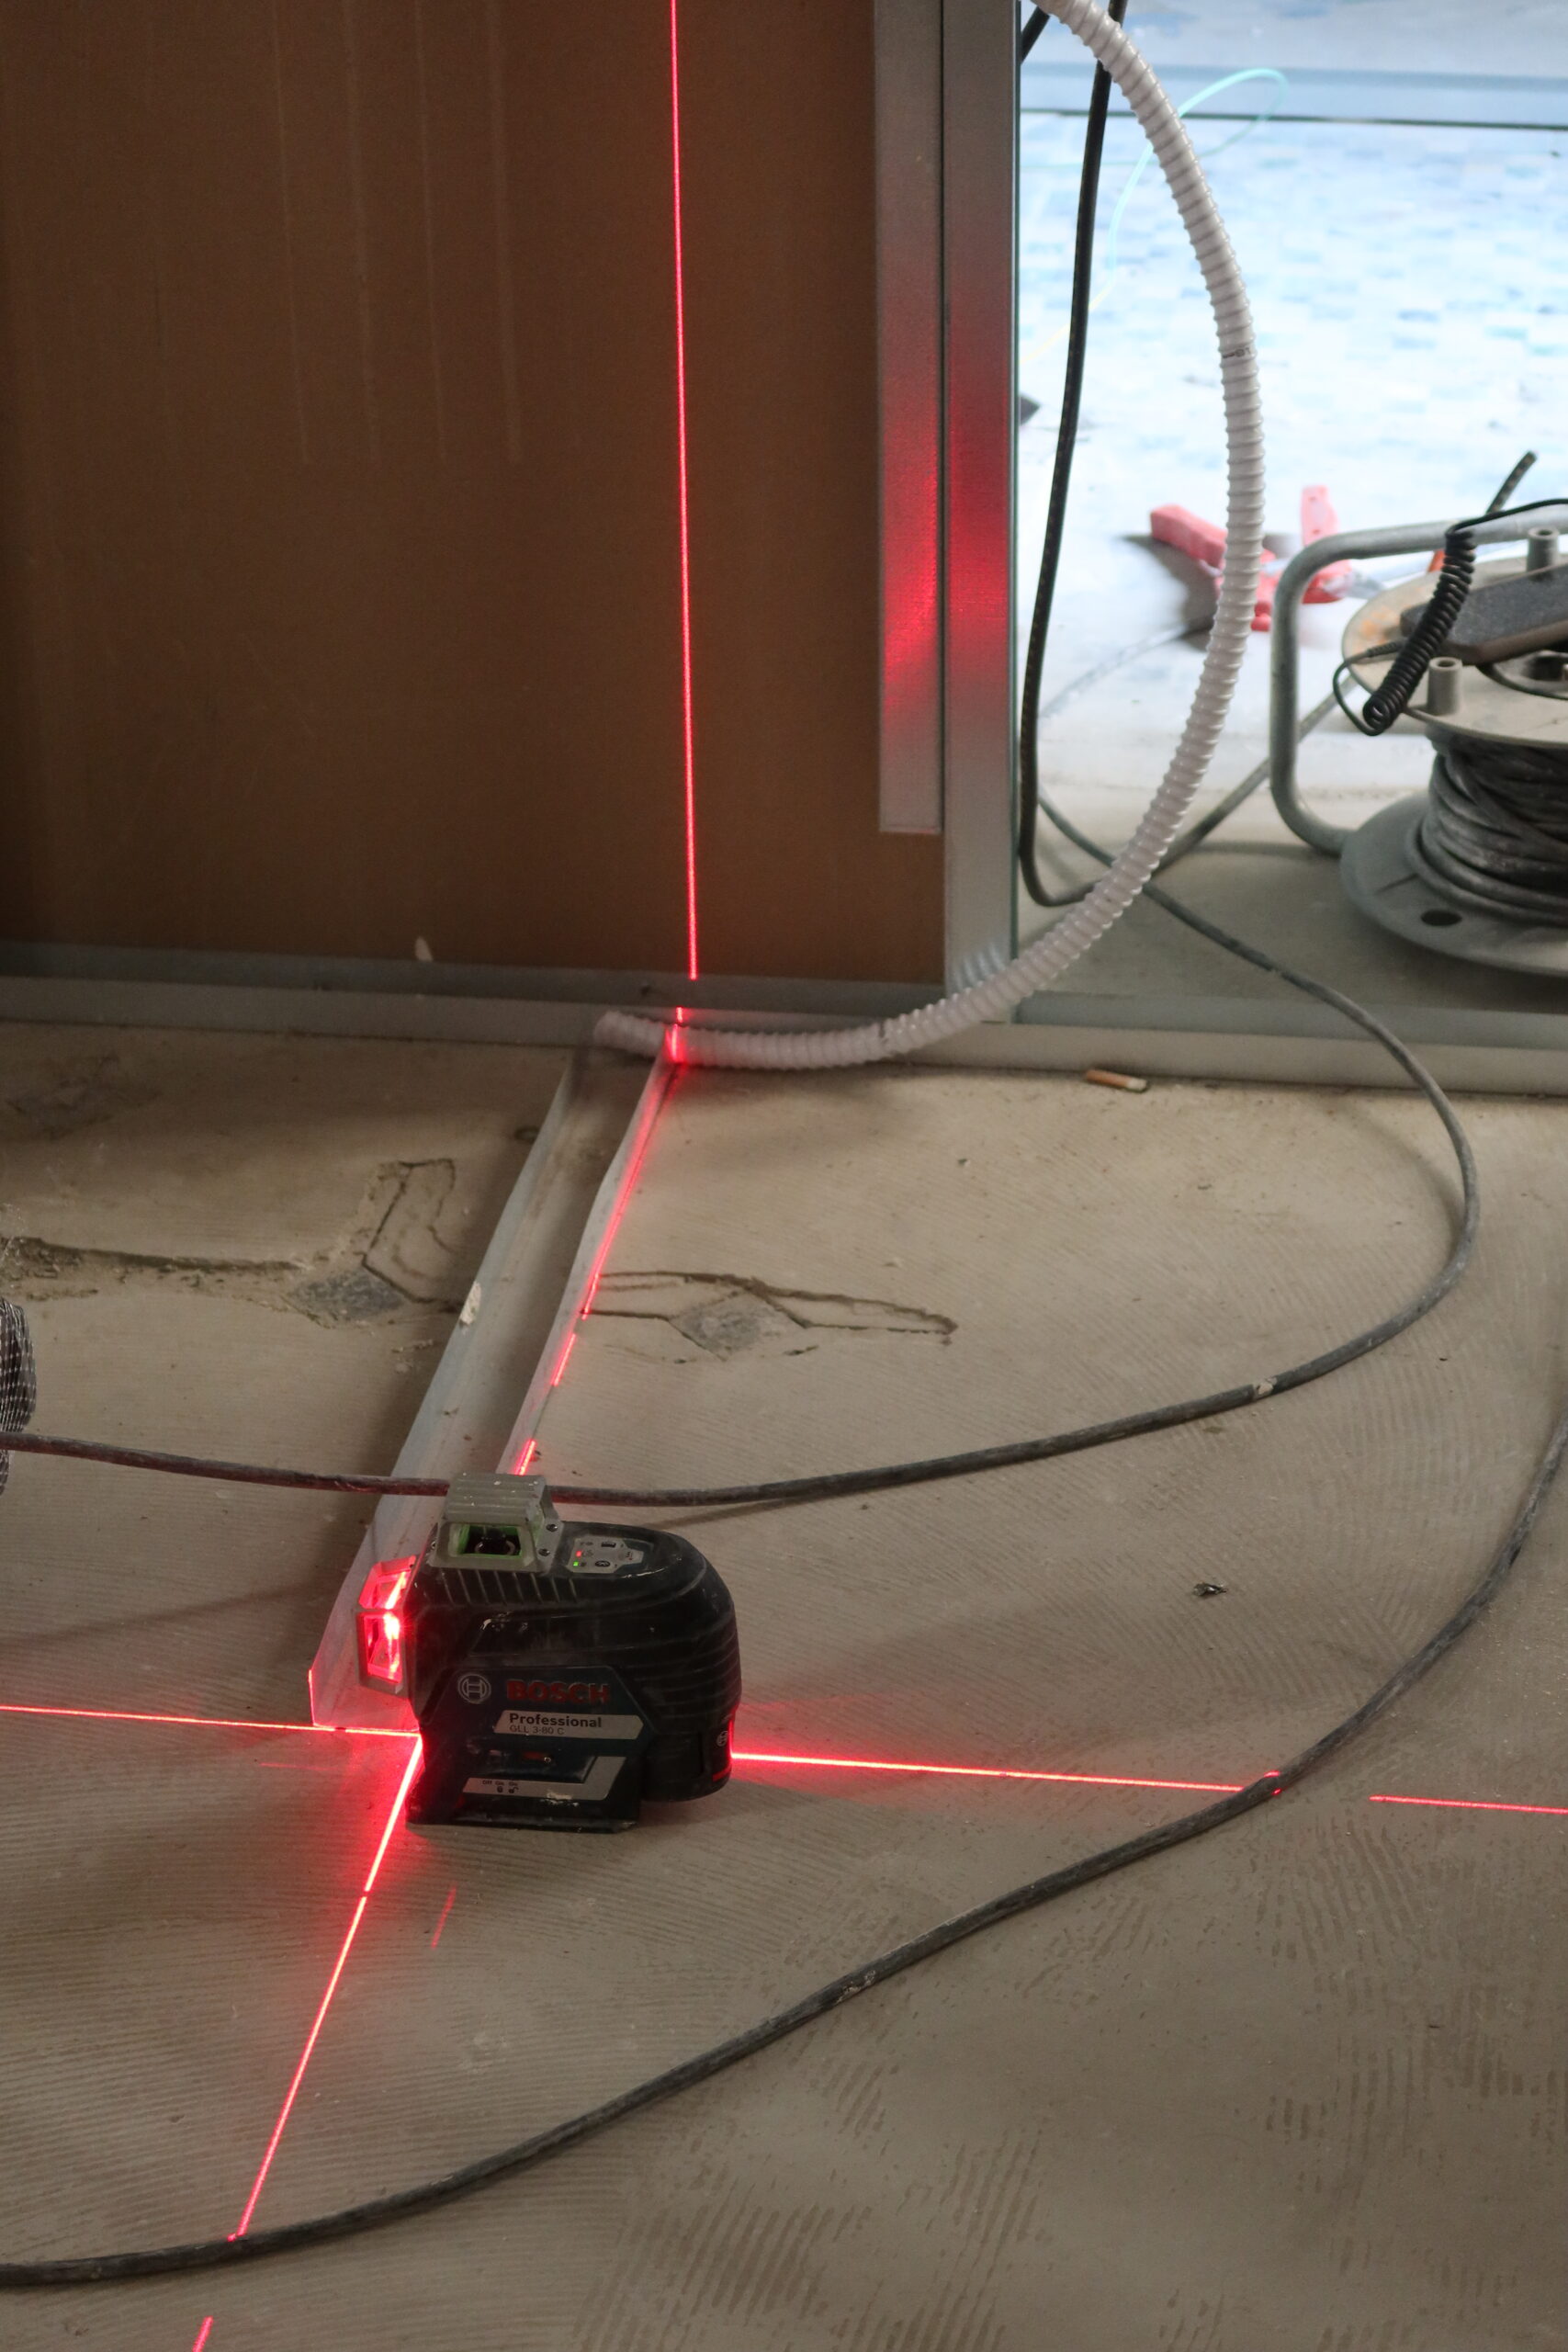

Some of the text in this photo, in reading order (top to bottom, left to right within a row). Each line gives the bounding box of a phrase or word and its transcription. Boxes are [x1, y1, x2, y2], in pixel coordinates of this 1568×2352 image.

[506, 1679, 611, 1704] BOSCH
[509, 1713, 602, 1727] Professional
[509, 1724, 565, 1736] GLL 3-80 C
